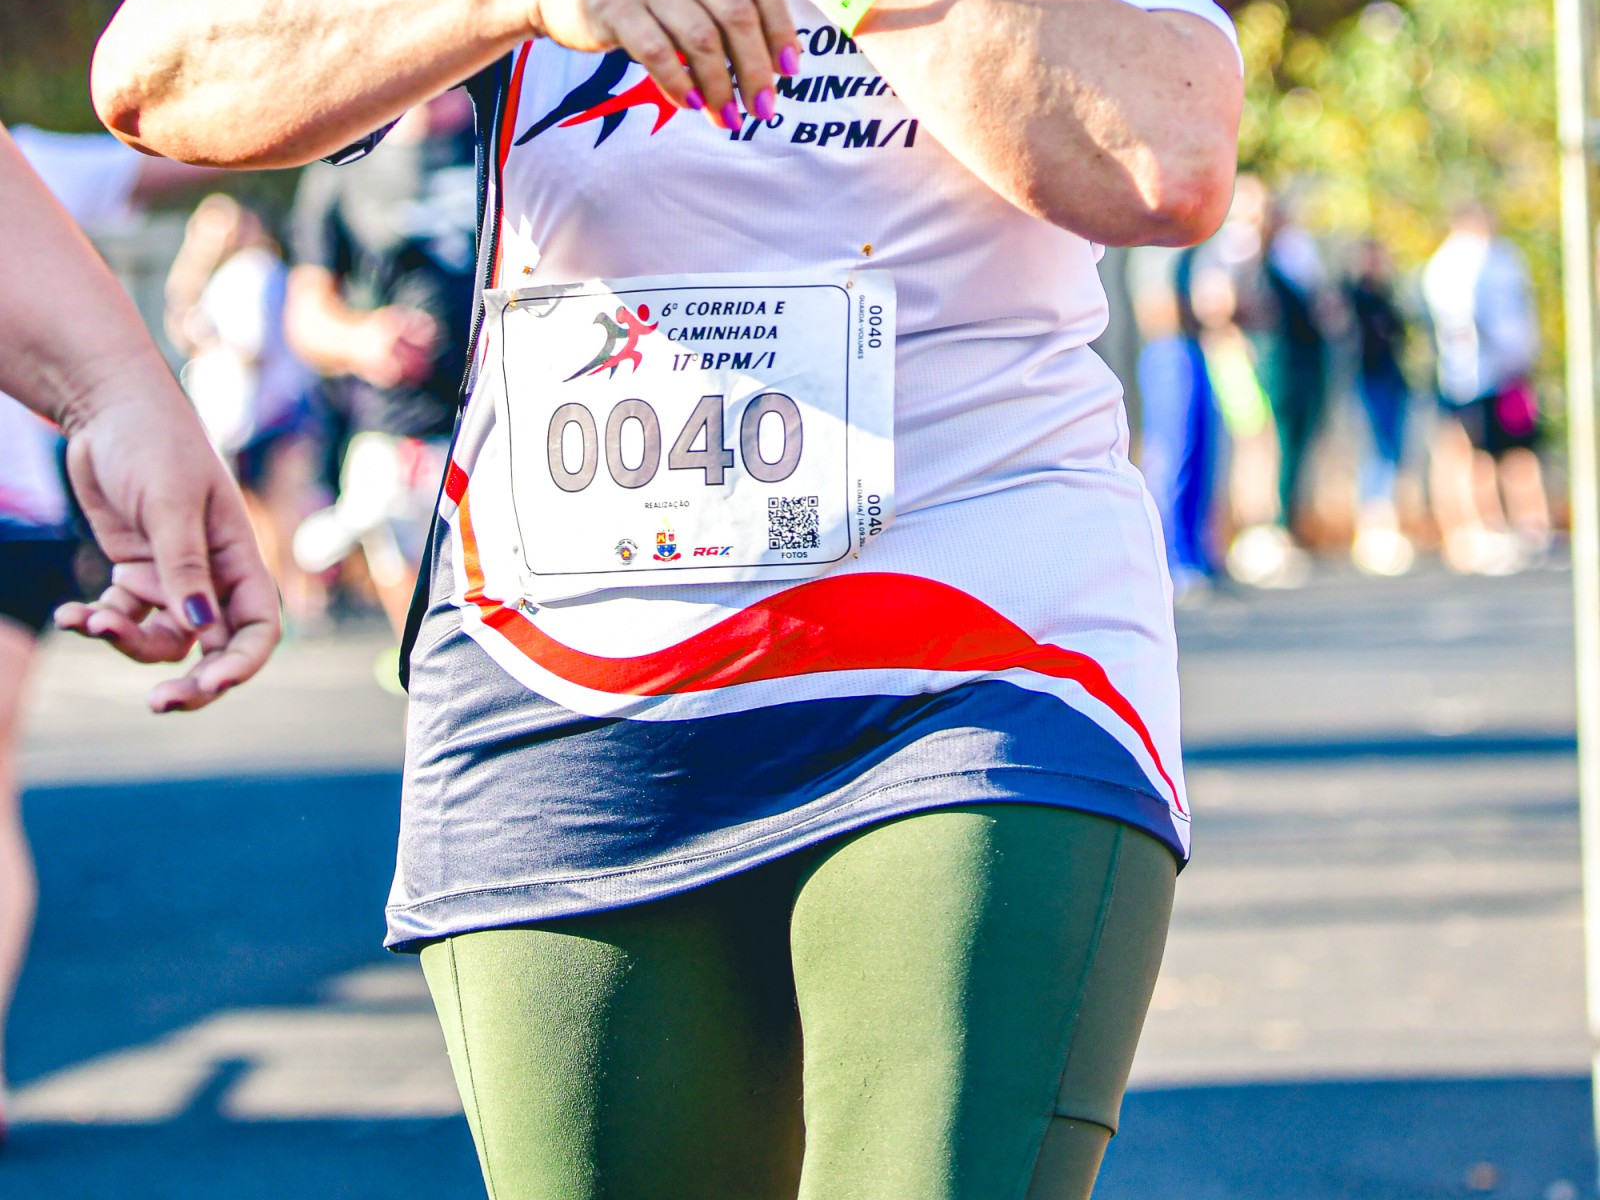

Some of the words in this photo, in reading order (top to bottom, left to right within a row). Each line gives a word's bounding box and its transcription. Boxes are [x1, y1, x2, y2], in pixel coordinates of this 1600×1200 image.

[790, 118, 919, 149] BPM/I
[685, 301, 766, 316] CORRIDA
[774, 301, 786, 315] E
[667, 325, 778, 341] CAMINHADA
[857, 294, 865, 360] GUARDA-VOLUMES
[868, 305, 883, 349] 0040
[701, 351, 776, 370] BPM/I
[547, 392, 803, 493] 0040
[644, 500, 690, 510] REALIZAÇÃO
[867, 494, 883, 536] 0040
[781, 551, 808, 559] FOTOS
